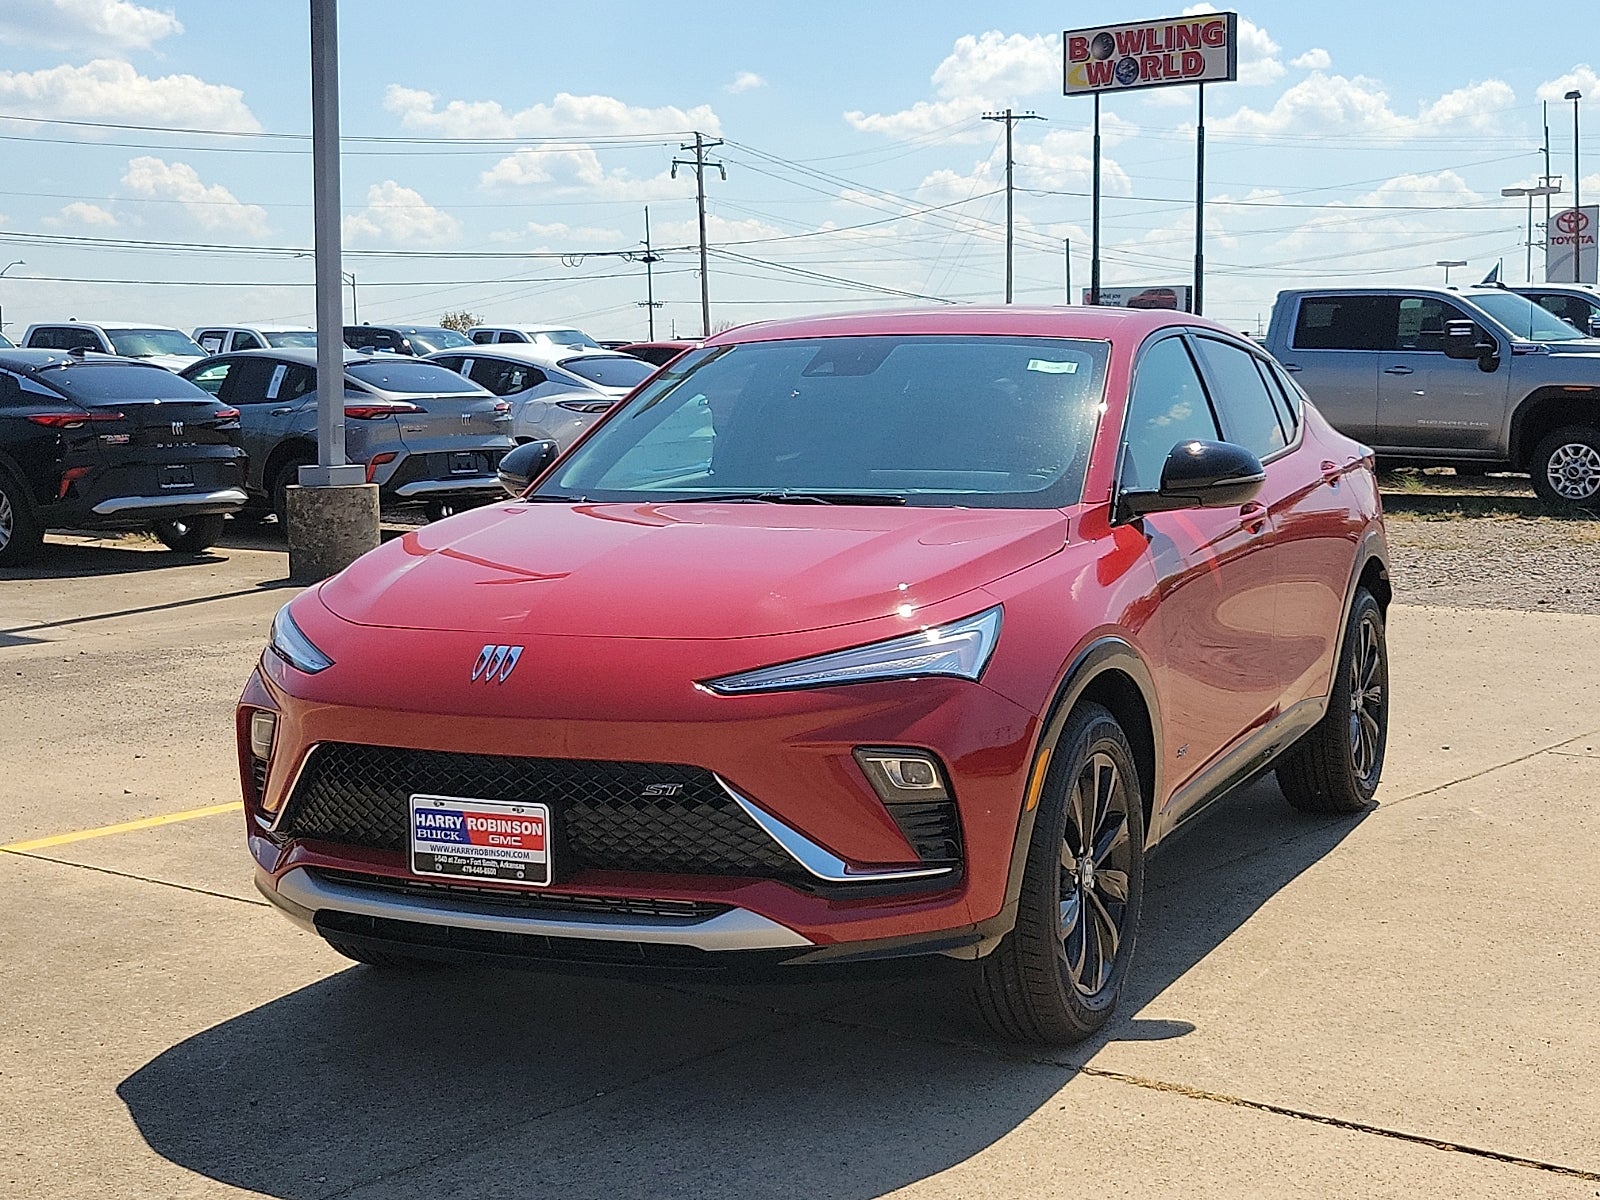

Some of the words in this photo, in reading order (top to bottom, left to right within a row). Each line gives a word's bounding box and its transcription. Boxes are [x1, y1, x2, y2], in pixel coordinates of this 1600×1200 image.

[1068, 21, 1224, 61] BOWLING
[1085, 51, 1205, 87] WORLD
[641, 783, 683, 796] ST
[416, 813, 463, 829] HARRY
[467, 817, 543, 836] ROBINSON
[489, 834, 523, 846] GMC
[429, 844, 530, 859] WWW.HARRYROBINSON.COM
